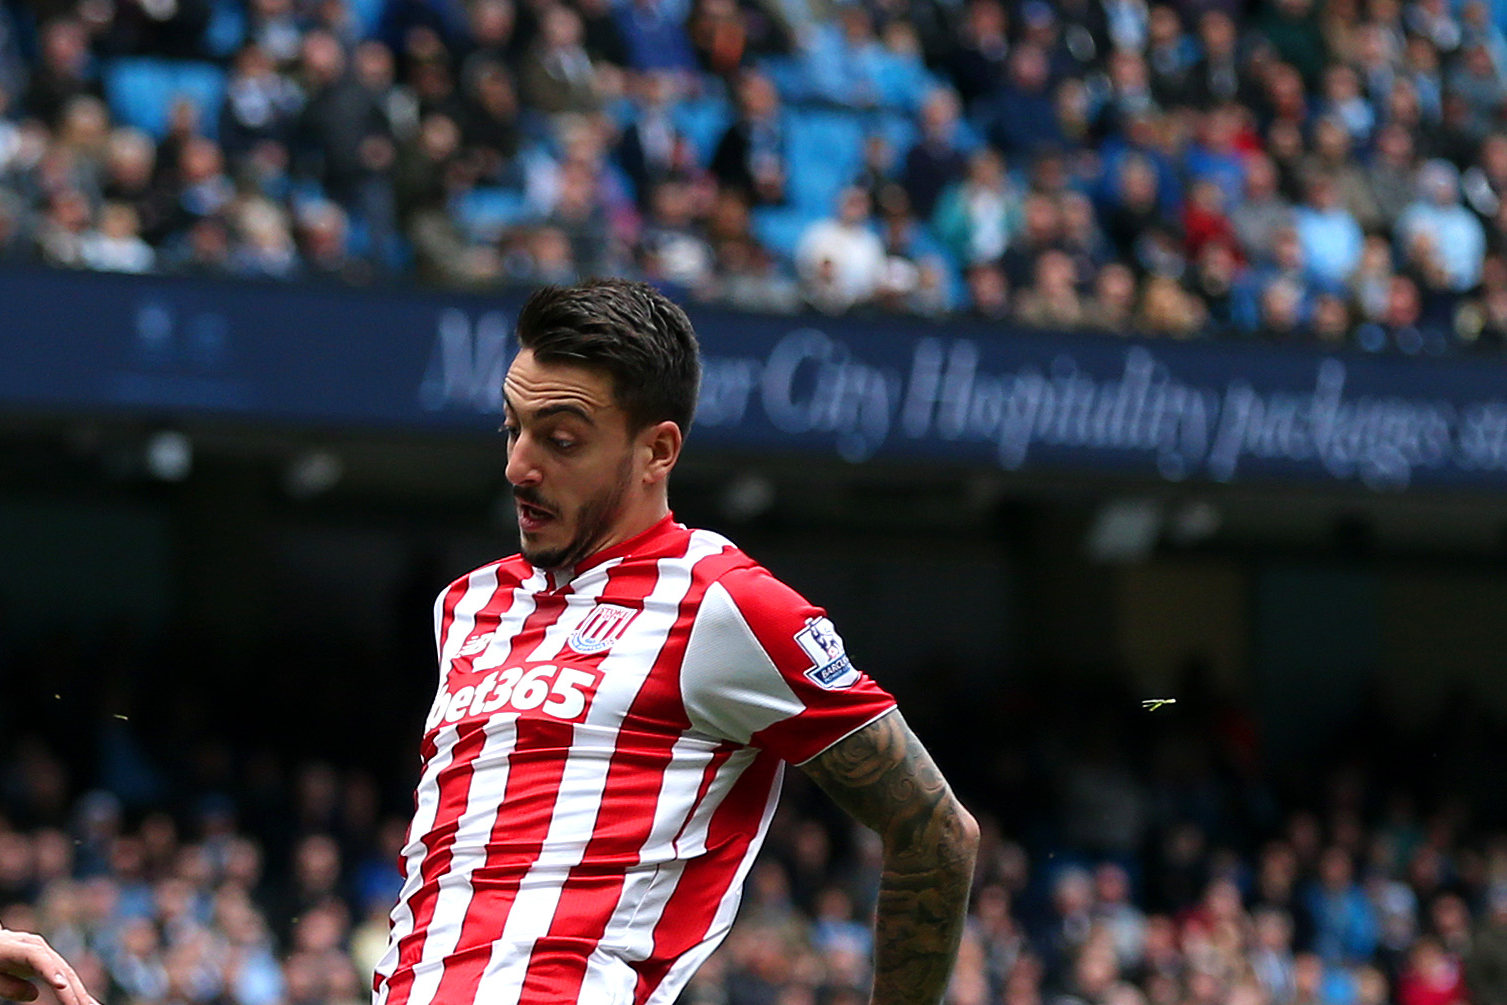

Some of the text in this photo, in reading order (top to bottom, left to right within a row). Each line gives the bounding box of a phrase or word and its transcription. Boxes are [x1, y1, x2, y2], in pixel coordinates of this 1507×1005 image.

[763, 327, 901, 464] City
[903, 336, 1219, 483] Hospitality
[1208, 358, 1454, 494] packages
[425, 665, 596, 730] bet365
